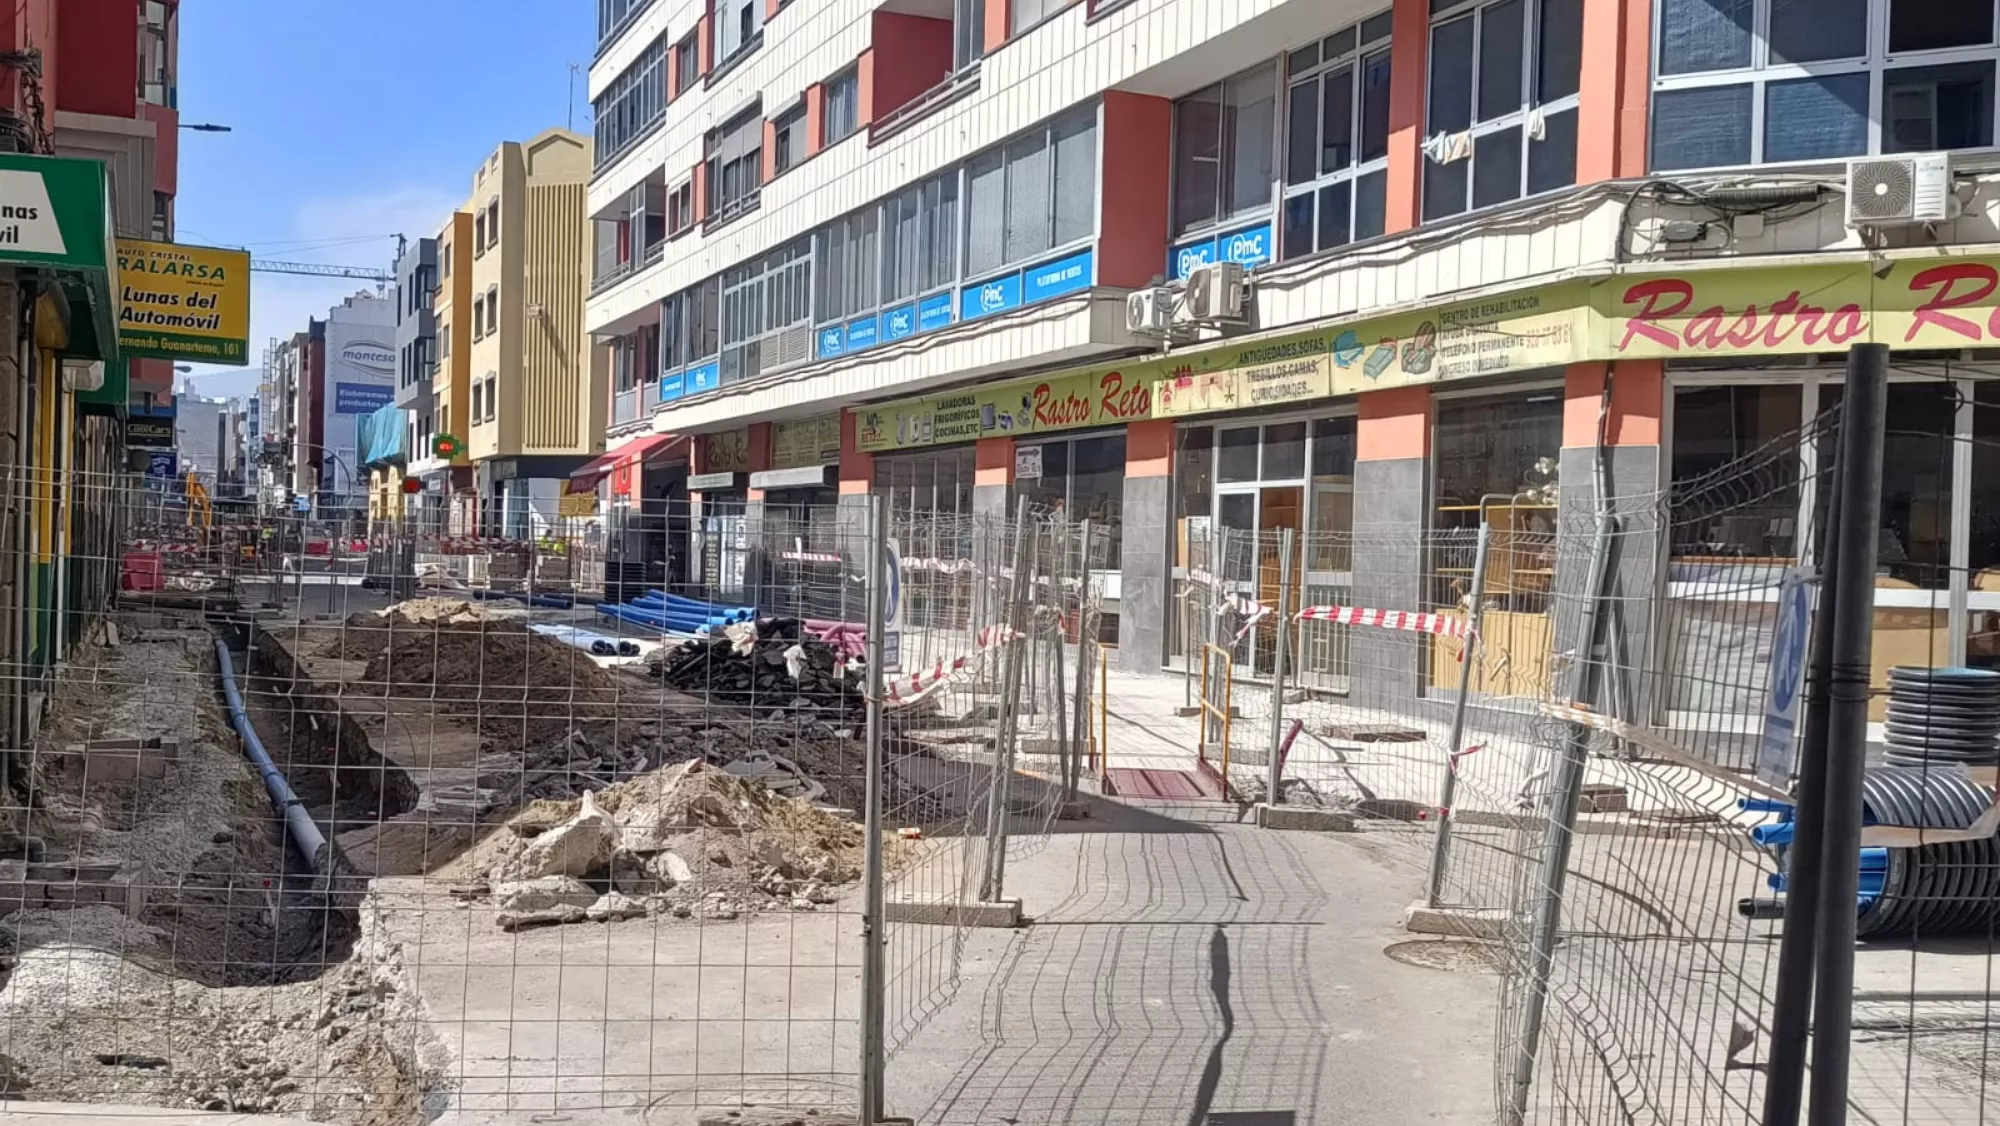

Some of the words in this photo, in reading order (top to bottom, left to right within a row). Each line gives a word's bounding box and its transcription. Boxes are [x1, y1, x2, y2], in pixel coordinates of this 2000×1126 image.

[150, 251, 191, 261] CRISTAL
[118, 257, 225, 280] RALARSA
[123, 286, 179, 305] Lunas
[186, 291, 217, 309] del
[1904, 262, 2000, 342] R
[119, 306, 220, 329] Automóvil
[1470, 306, 1480, 319] DE
[1619, 278, 1869, 352] Rastro
[120, 335, 158, 348] ernando
[343, 351, 395, 362] montesa
[937, 395, 976, 411] LAVADORAS
[1032, 383, 1091, 431] Rastro
[1099, 372, 1150, 420] Reto
